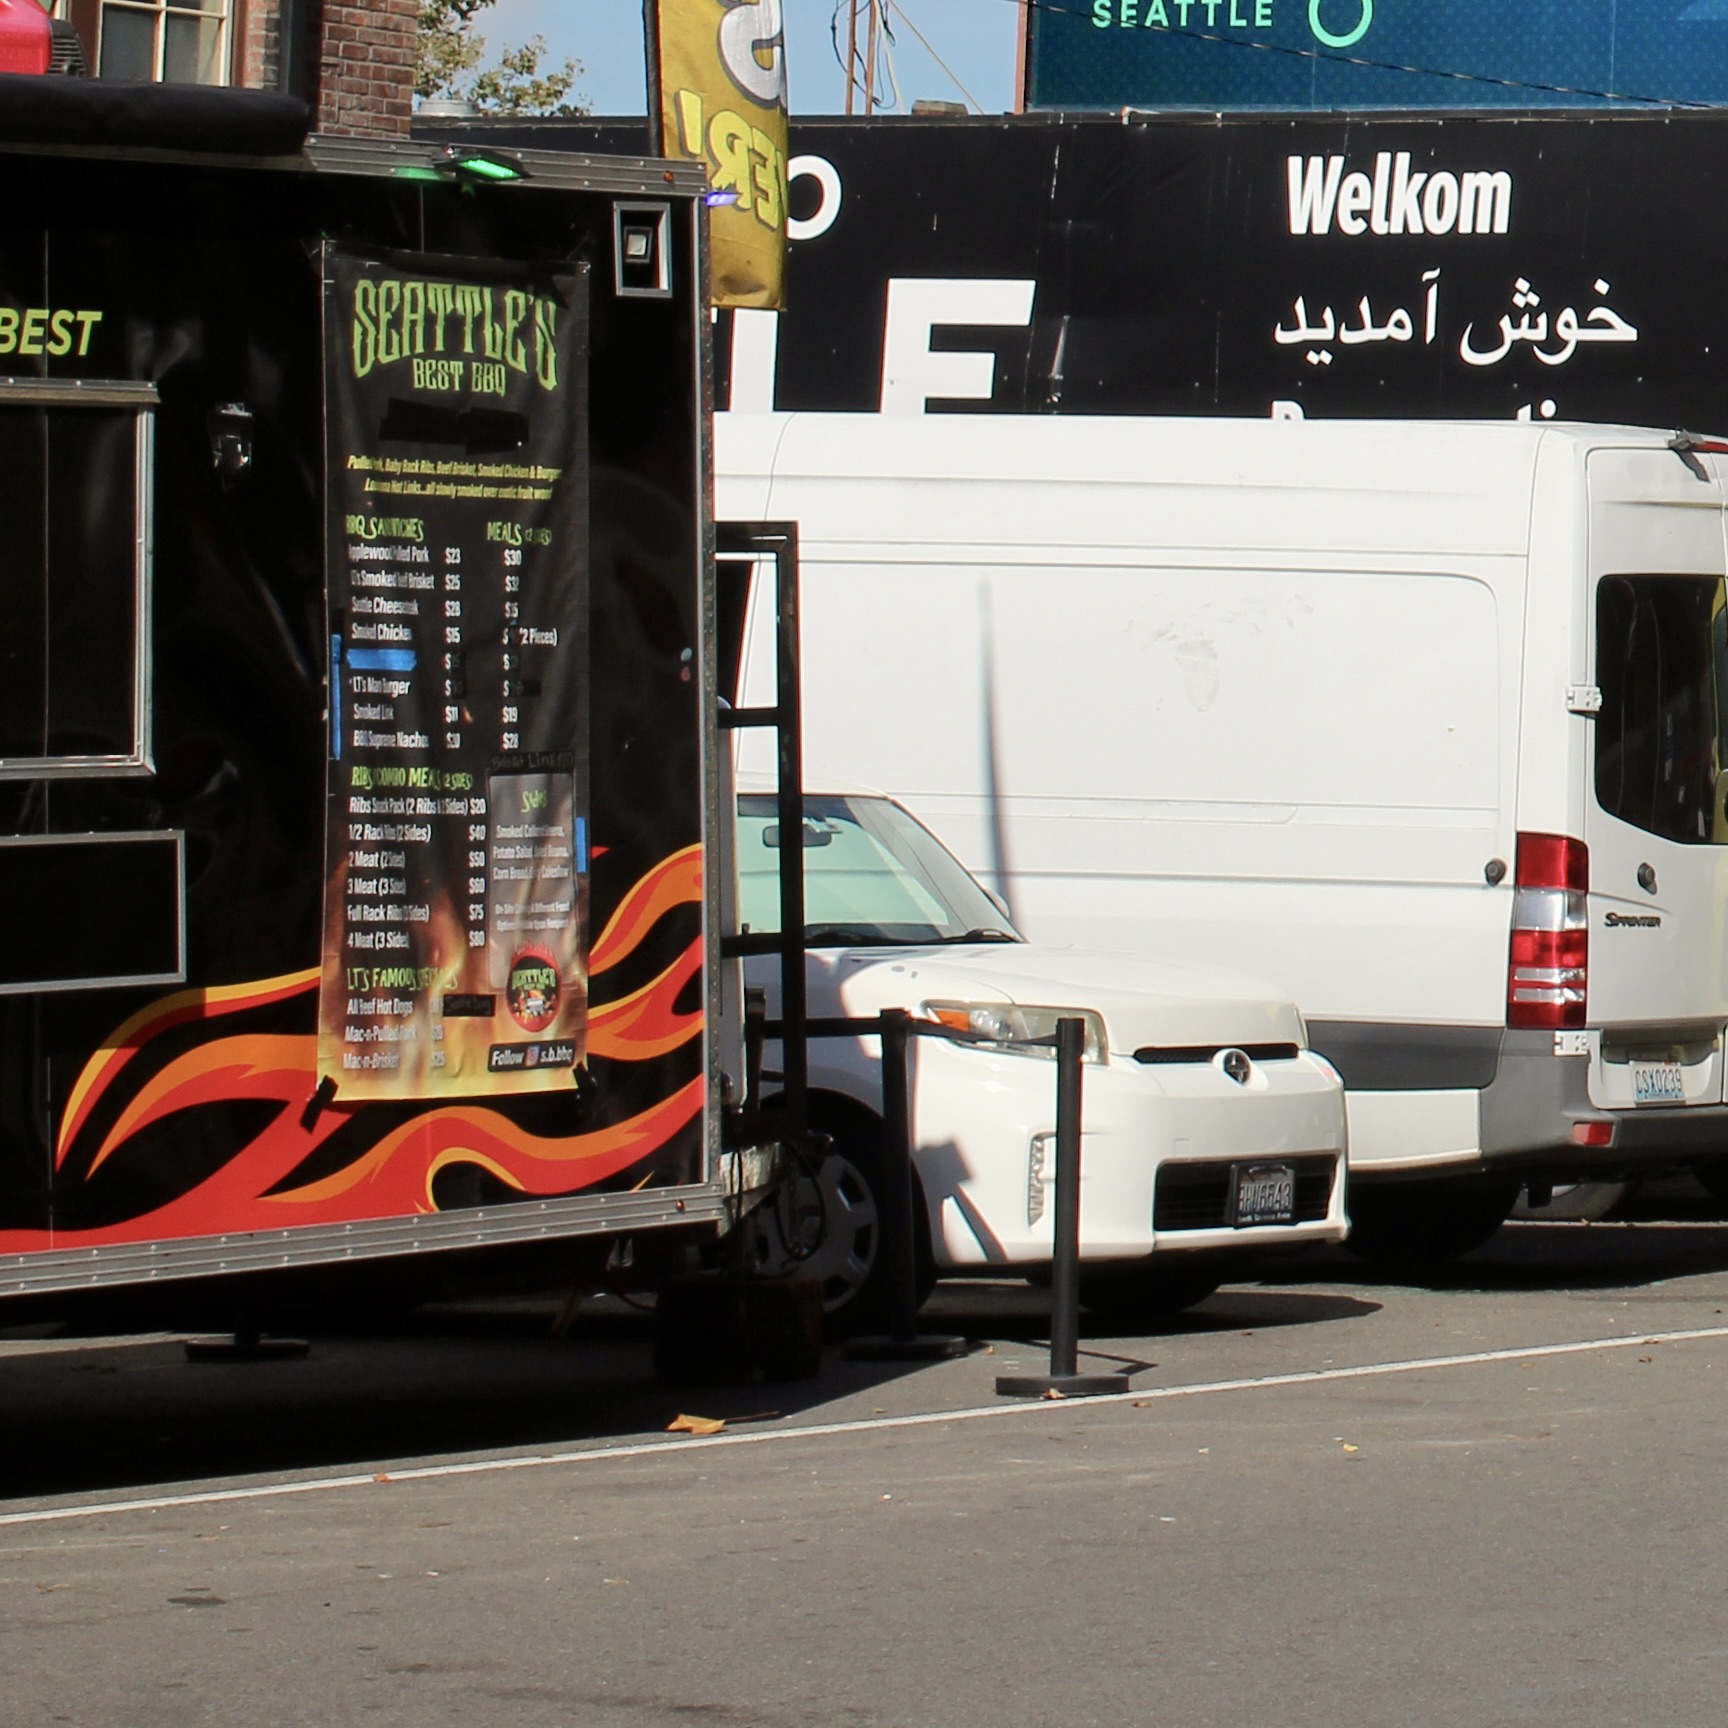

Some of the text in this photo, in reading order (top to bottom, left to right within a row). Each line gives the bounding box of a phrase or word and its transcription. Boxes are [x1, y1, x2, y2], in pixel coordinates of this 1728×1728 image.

[1287, 152, 1512, 236] Welkom
[1459, 277, 1638, 366] خوش
[0, 309, 102, 355] BEST
[353, 279, 558, 390] SEATTLE'S
[413, 359, 506, 397] BEST BBQ
[487, 522, 521, 545] MEALS
[445, 547, 461, 564] $23
[504, 549, 522, 566] $30
[445, 626, 461, 644] $15
[445, 705, 459, 722] $11
[503, 706, 518, 722] $19
[350, 797, 371, 813] Ribs
[470, 798, 486, 815] $20
[469, 824, 485, 841] $40
[355, 851, 379, 867] Meat
[469, 851, 485, 867] $50
[354, 878, 377, 894] Meat
[469, 904, 484, 921] $75
[491, 1049, 524, 1066] Follow
[1634, 1068, 1683, 1094] CSX0239
